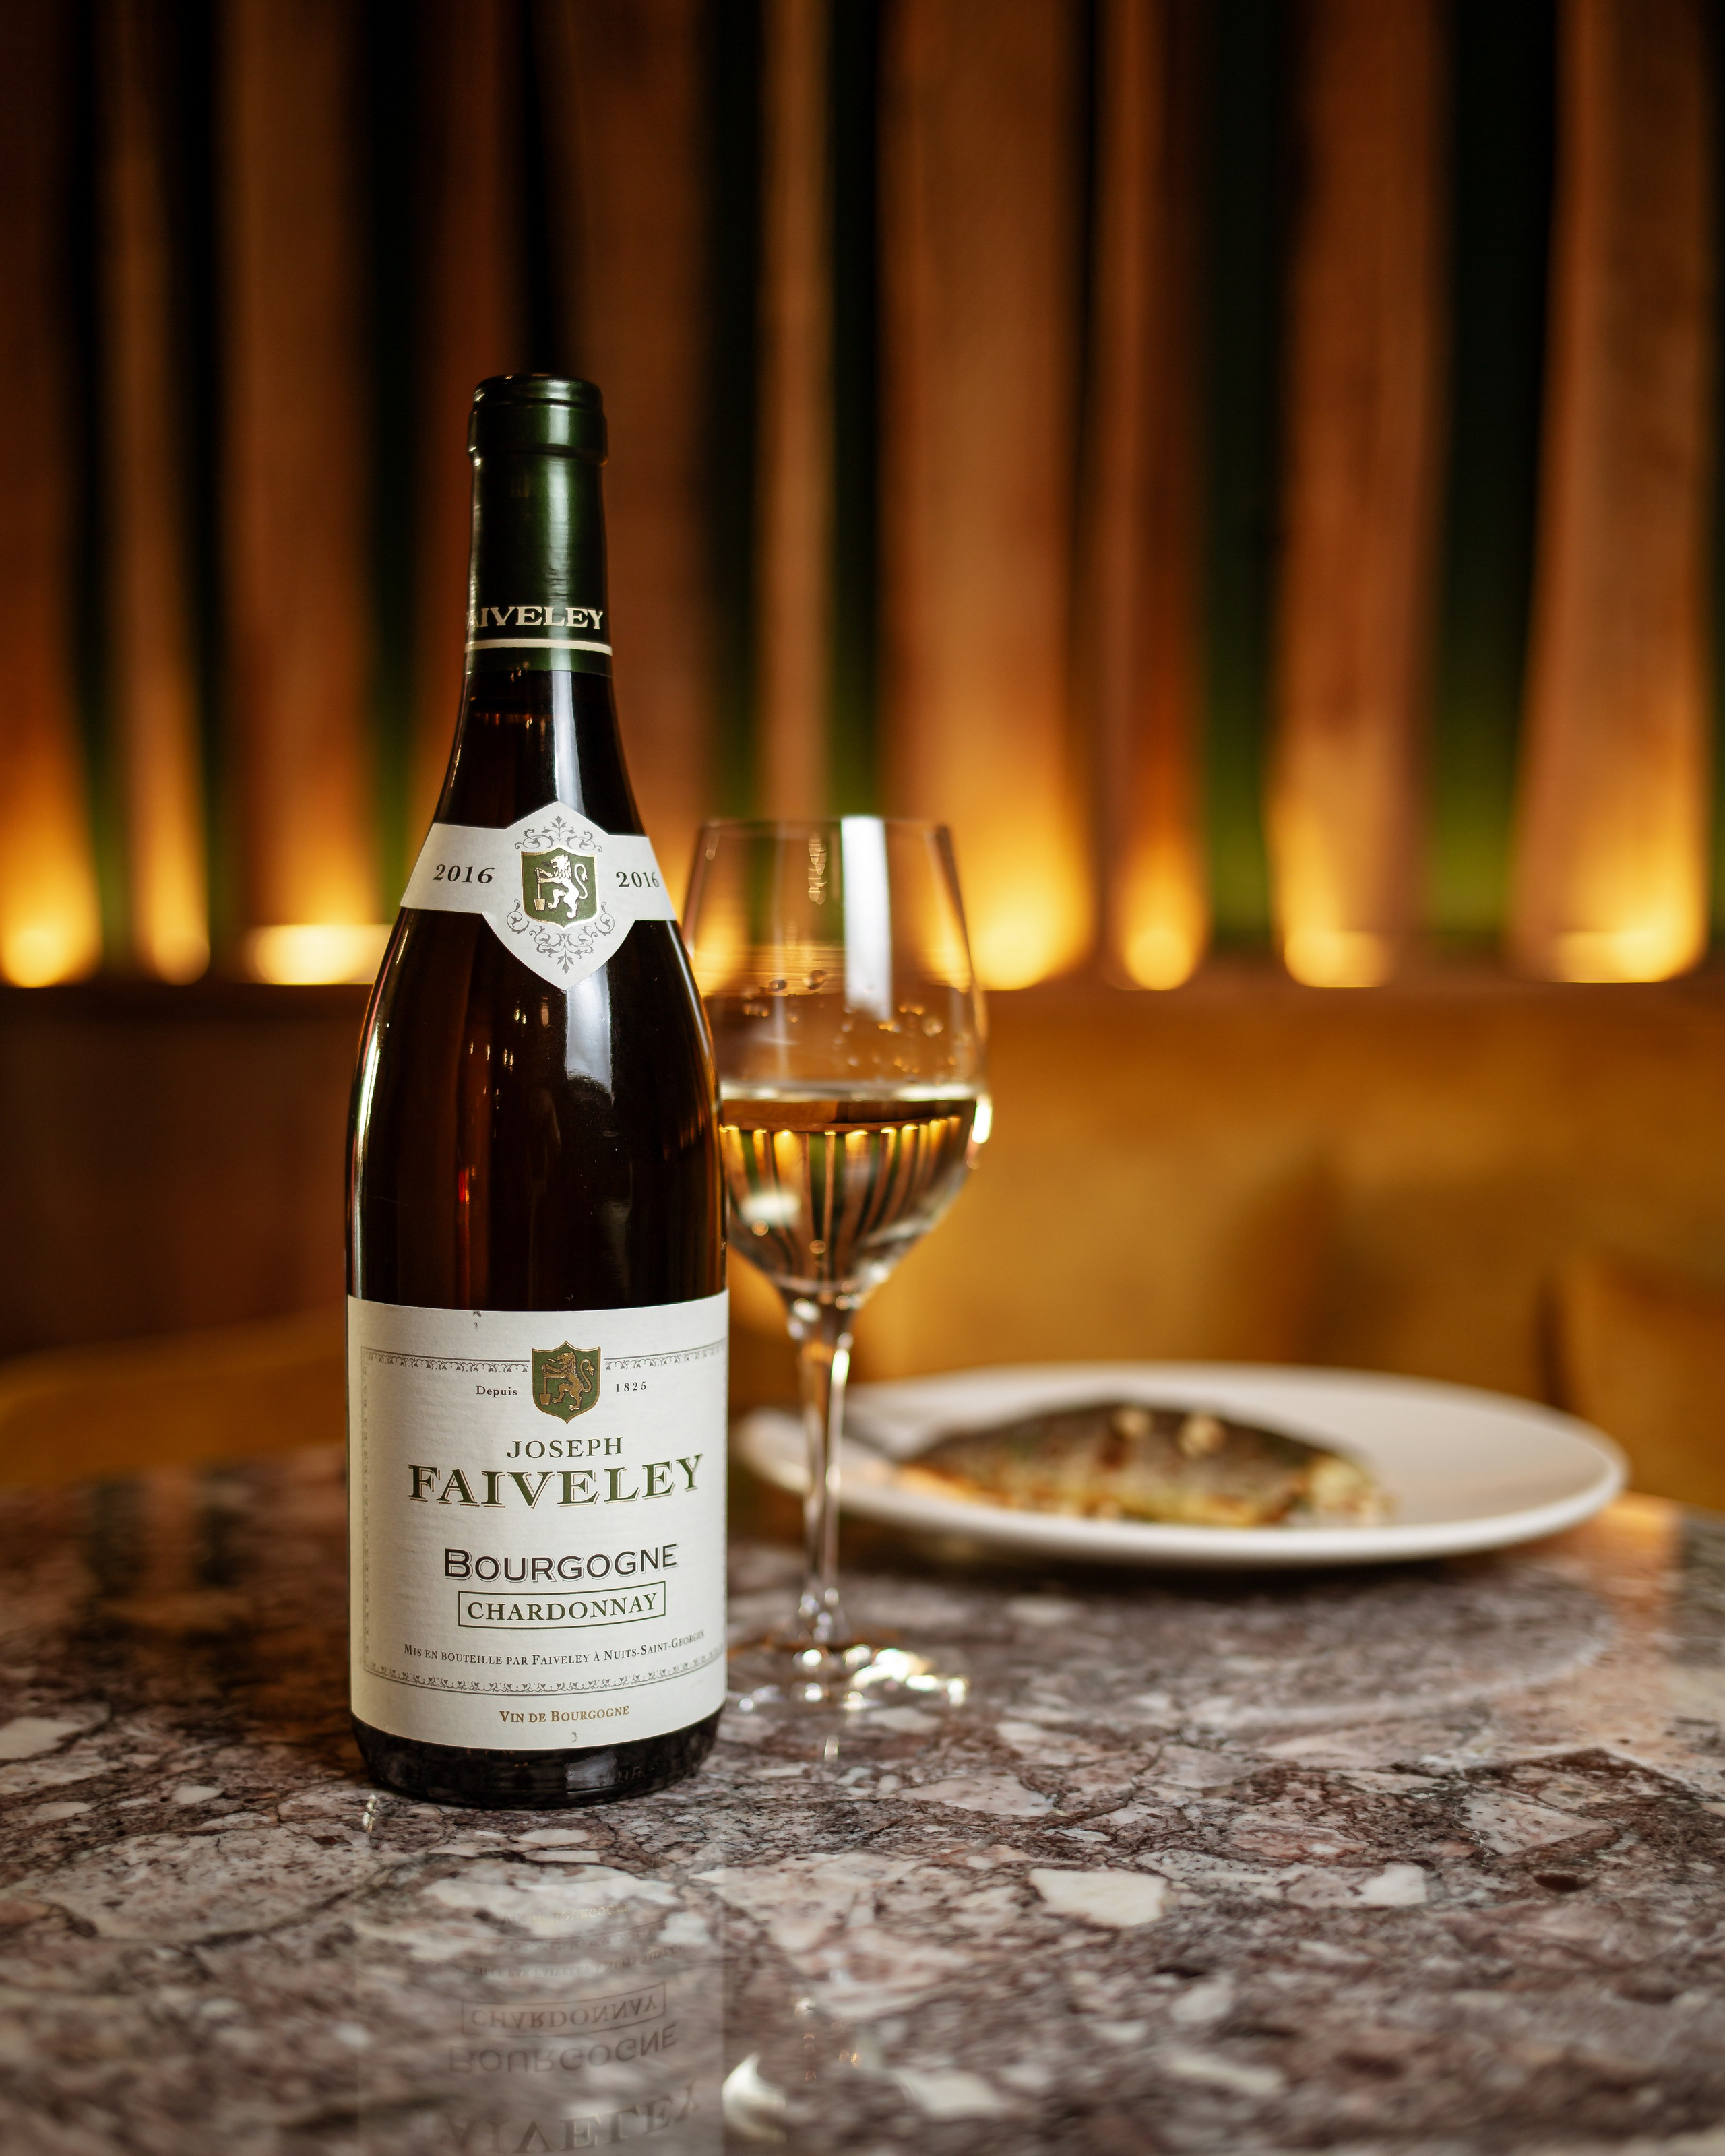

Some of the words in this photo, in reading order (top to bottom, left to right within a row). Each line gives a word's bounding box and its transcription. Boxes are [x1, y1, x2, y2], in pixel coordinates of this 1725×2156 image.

[466, 606, 603, 629] AIVELEY
[433, 864, 495, 884] 2016
[615, 870, 660, 888] 2016
[476, 1385, 518, 1398] Depuis
[616, 1381, 647, 1393] 1825
[506, 1436, 623, 1459] JOSEPH
[408, 1453, 703, 1509] FAIVELEY
[444, 1543, 679, 1583] BOURGOGNE
[467, 1592, 658, 1621] CHARDONNAY
[404, 1643, 422, 1657] MIS
[425, 1649, 438, 1659] EN
[441, 1651, 503, 1665] BOUTEILLE
[506, 1656, 528, 1666] PAR
[532, 1654, 590, 1666] FAIVELEY
[593, 1651, 600, 1662] À
[499, 1710, 524, 1723] VIN
[528, 1713, 546, 1723] DE
[551, 1705, 630, 1722] BOURGOGNE
